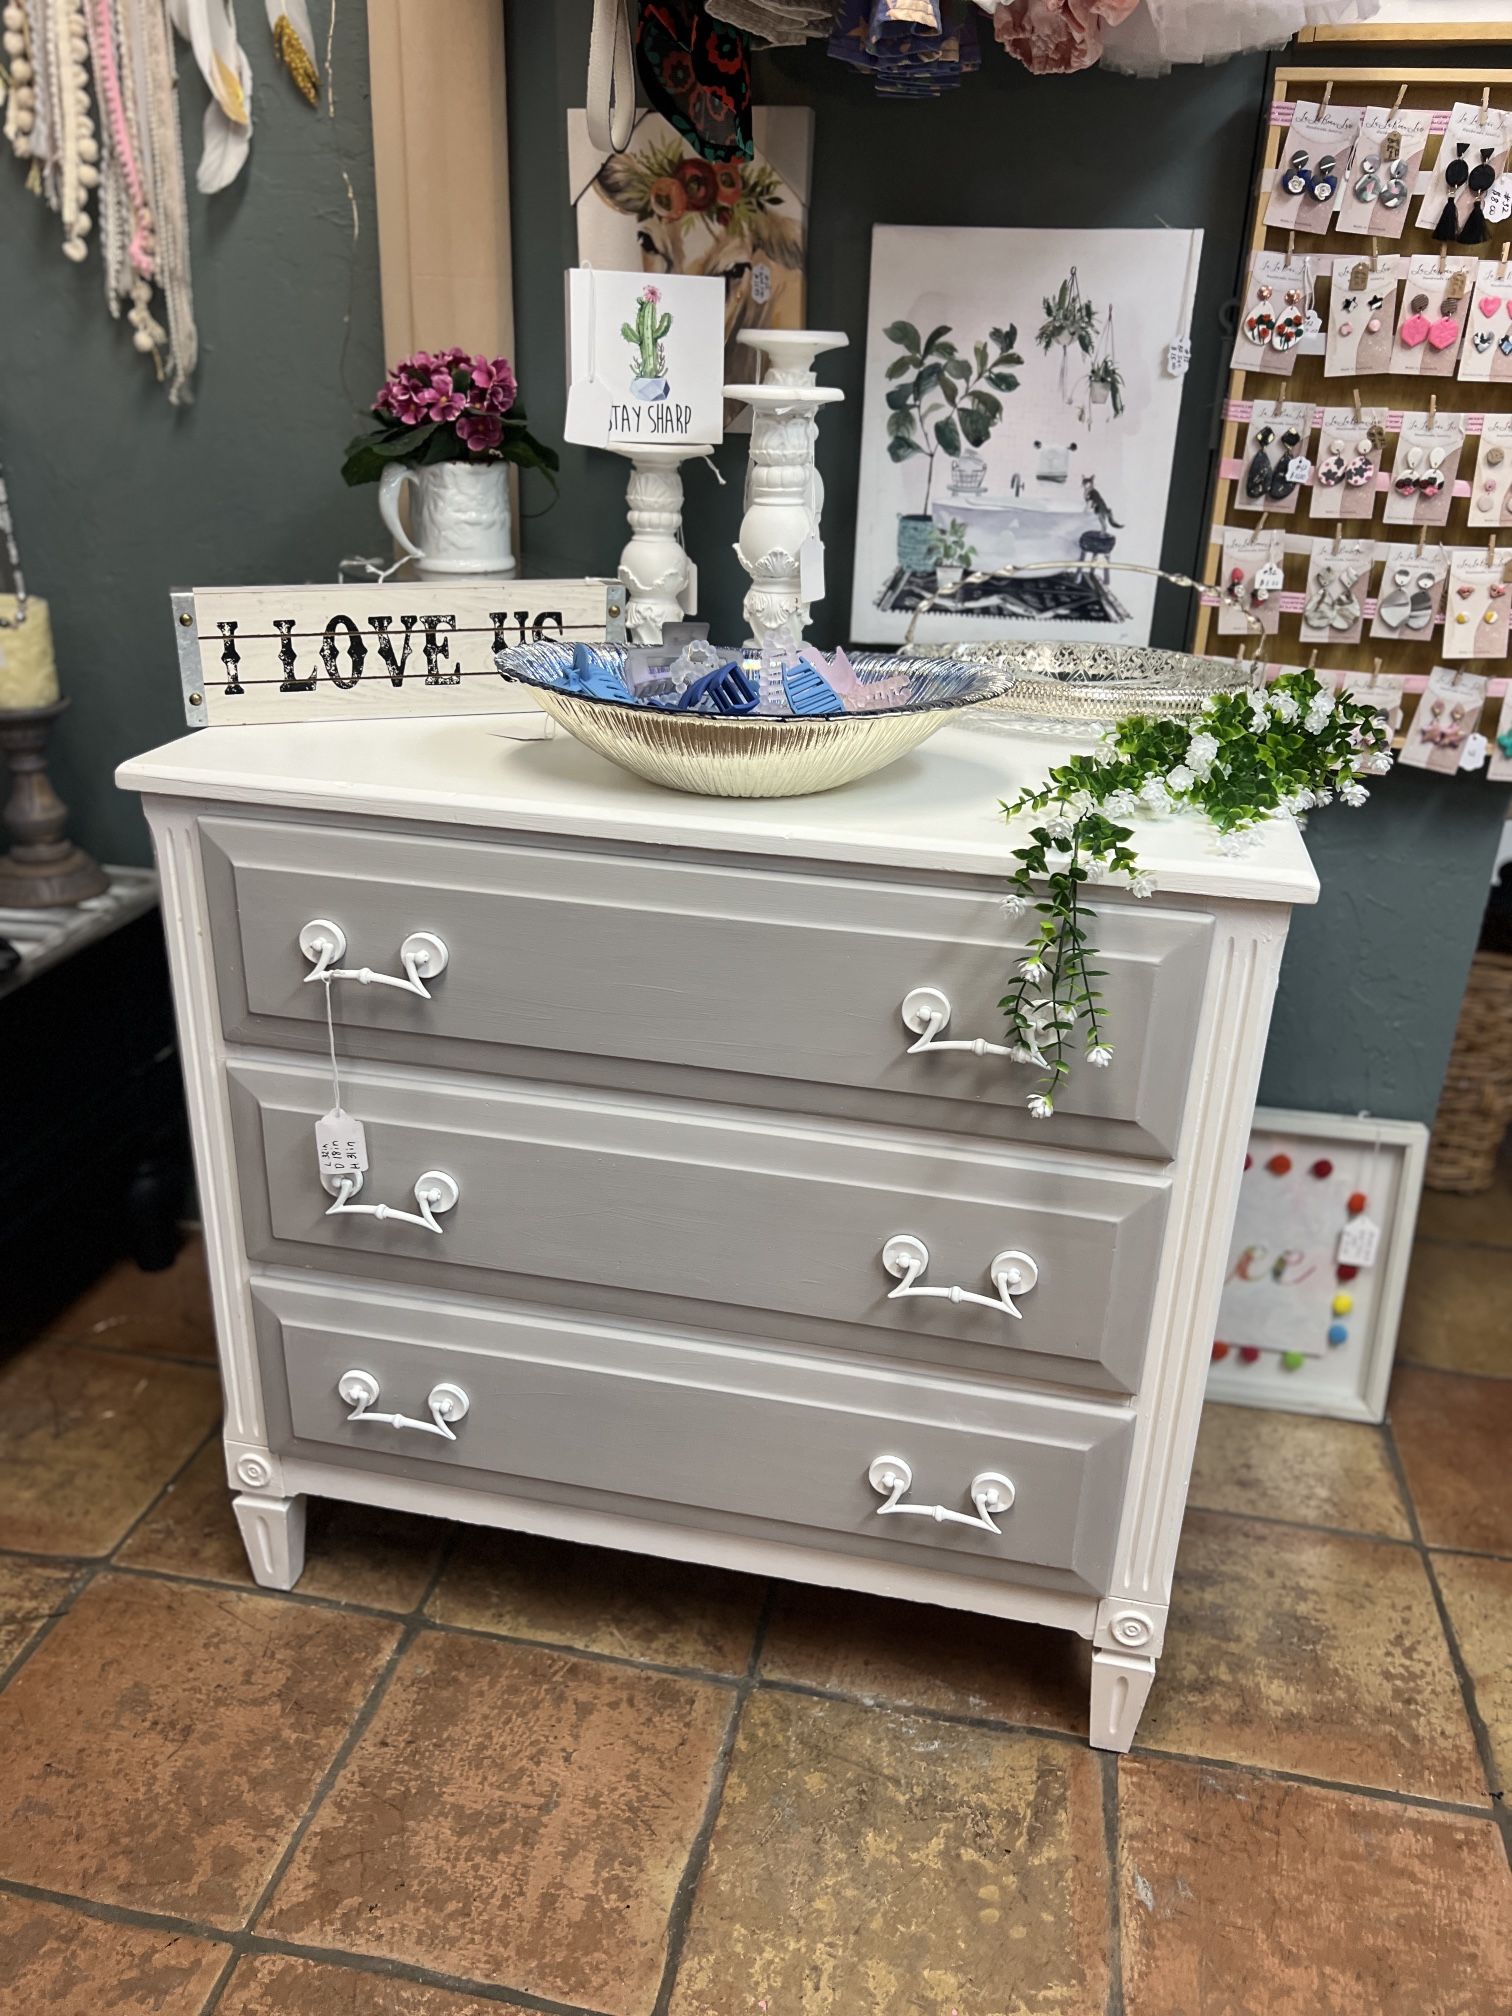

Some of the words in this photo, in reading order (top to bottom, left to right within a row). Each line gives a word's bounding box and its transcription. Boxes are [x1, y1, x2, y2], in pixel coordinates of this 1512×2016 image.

[608, 404, 641, 433] TAY
[648, 403, 692, 434] SHARP
[217, 621, 245, 695] I
[273, 614, 461, 692] LOVE
